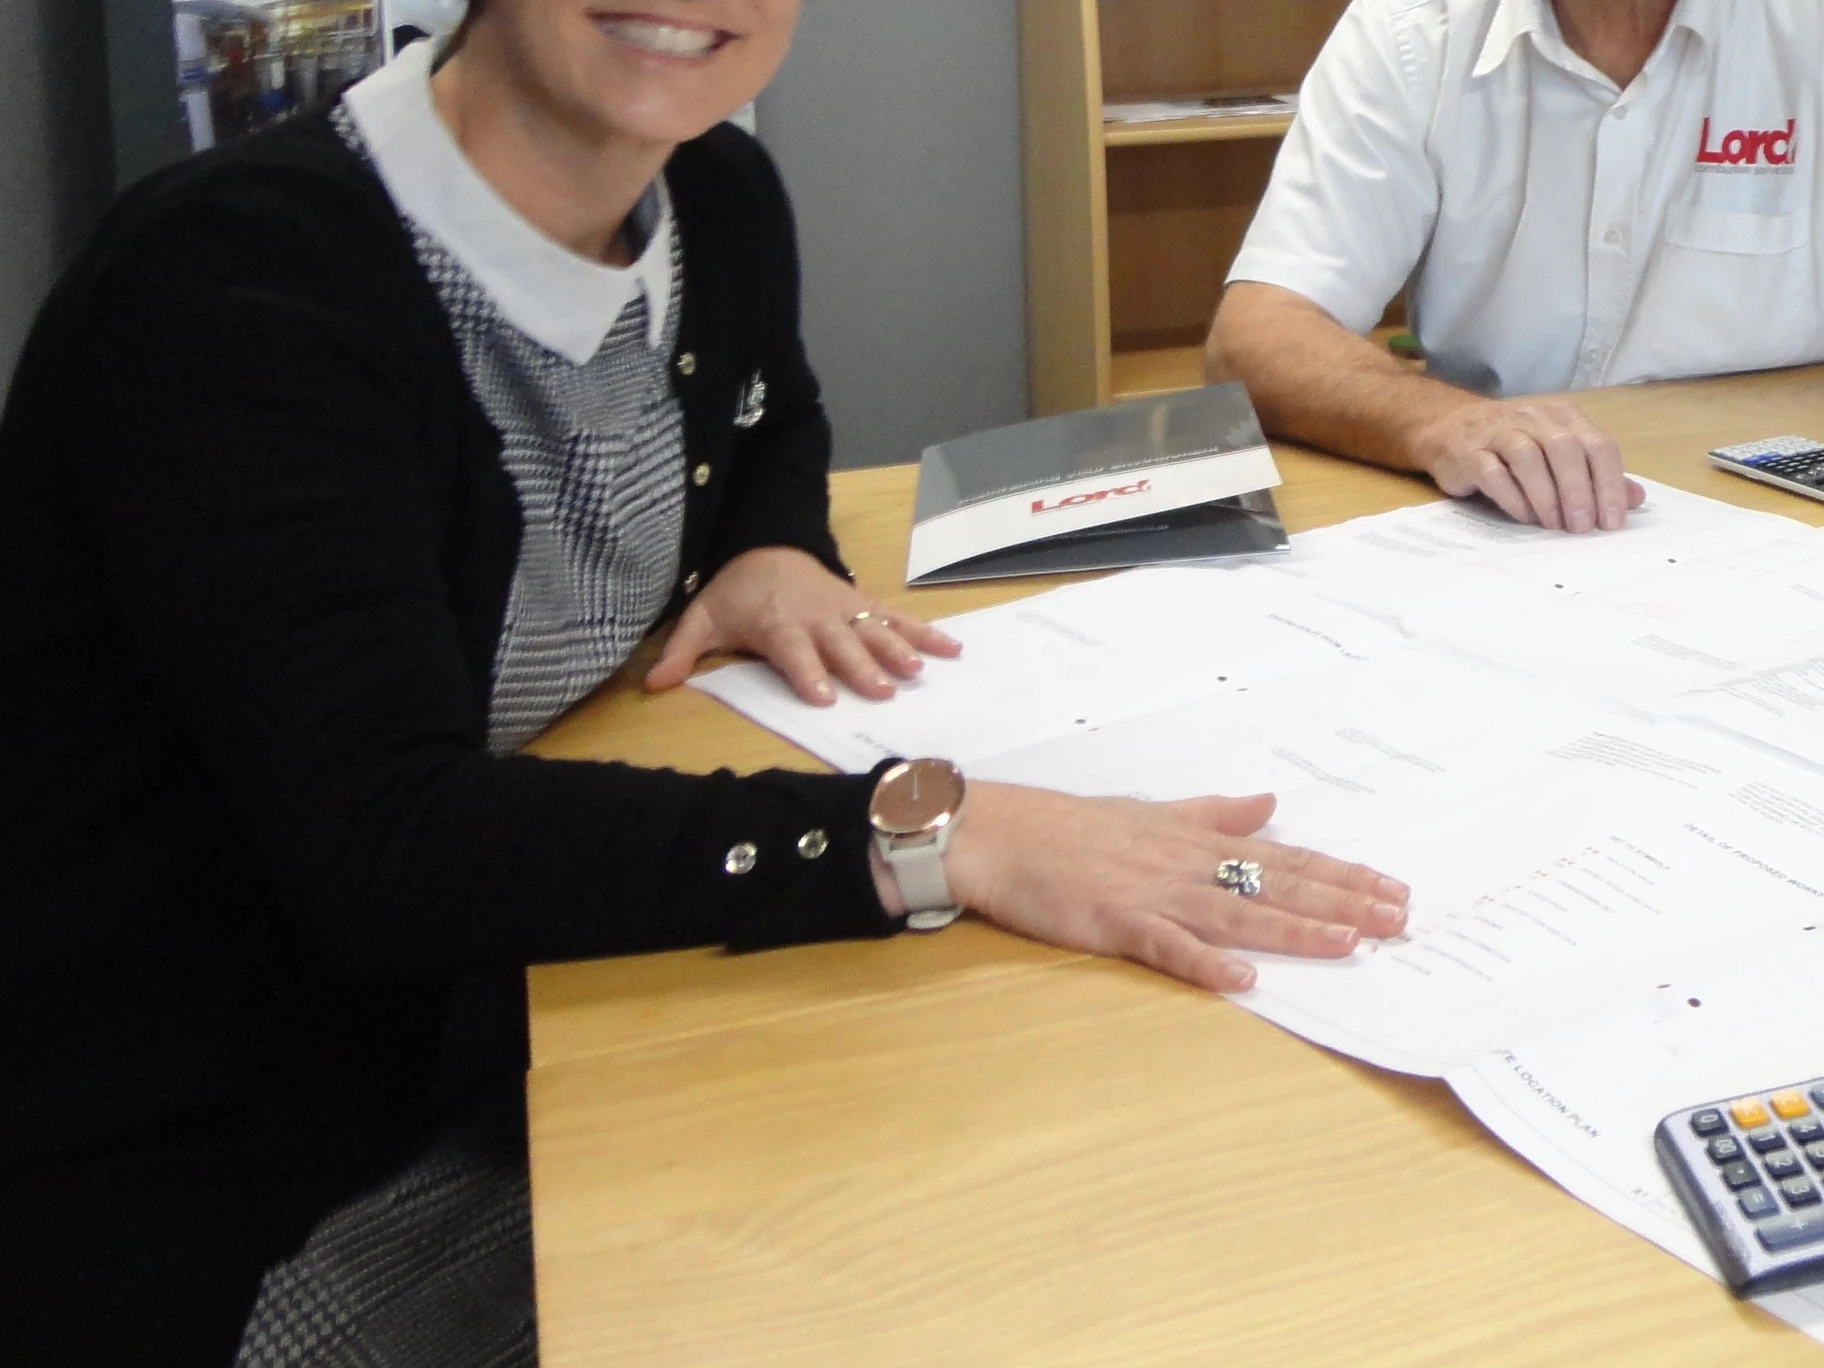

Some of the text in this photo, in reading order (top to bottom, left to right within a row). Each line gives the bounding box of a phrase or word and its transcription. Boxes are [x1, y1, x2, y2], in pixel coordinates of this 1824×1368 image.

[1696, 116, 1797, 165] Lord
[1031, 479, 1151, 514] Lord
[1514, 1064, 1570, 1114] LOCATION
